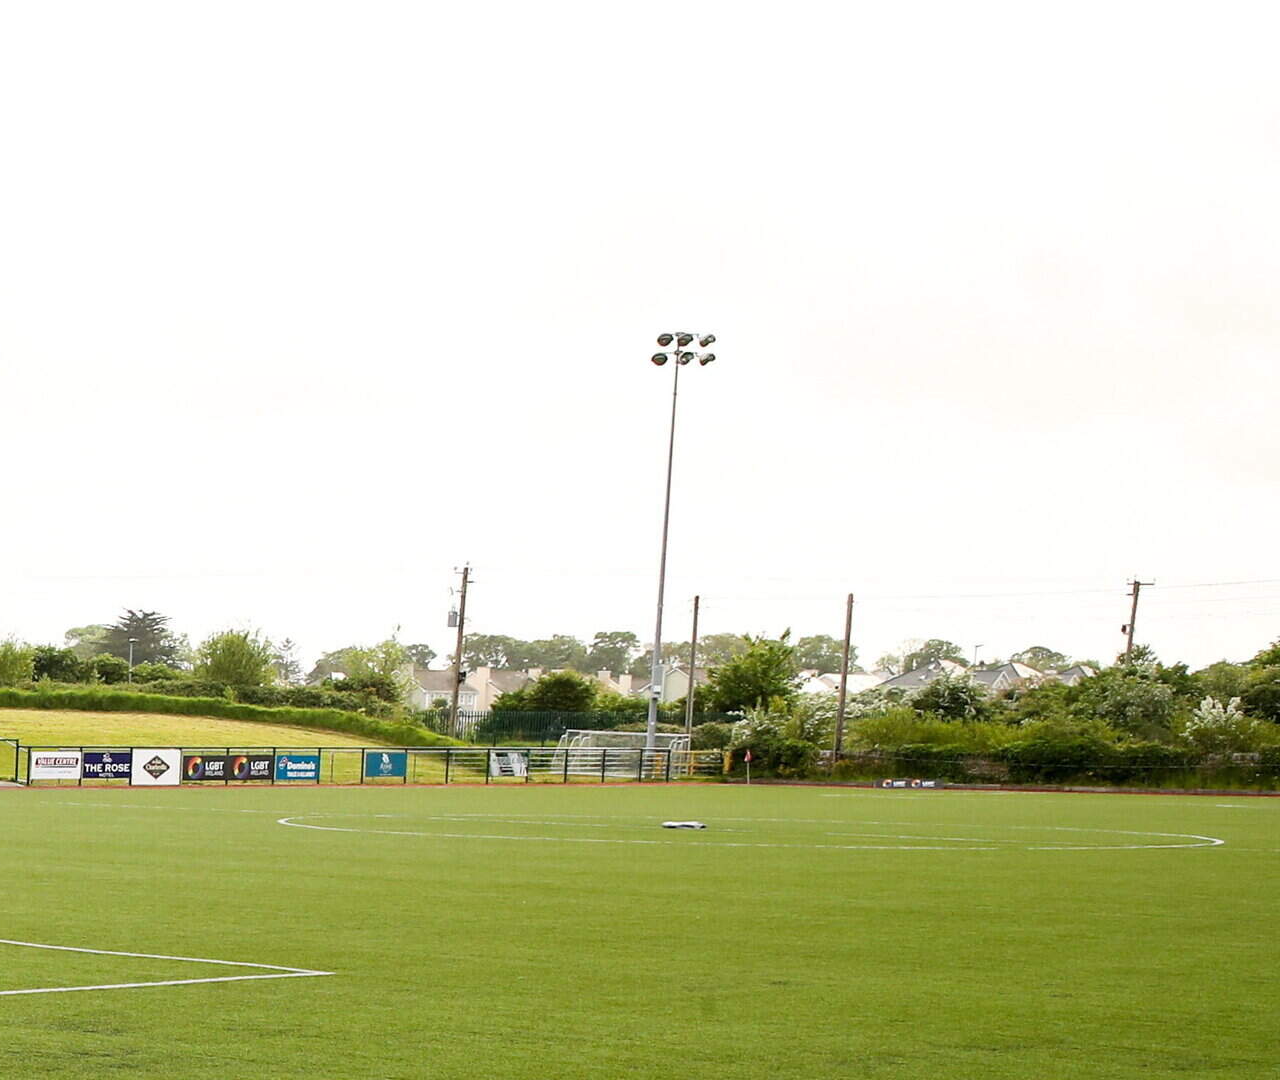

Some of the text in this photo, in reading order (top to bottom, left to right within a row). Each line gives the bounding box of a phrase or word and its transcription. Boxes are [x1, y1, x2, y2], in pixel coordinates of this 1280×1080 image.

[85, 763, 130, 772] THE ROSE
[205, 761, 224, 770] LGBT
[250, 761, 269, 770] LGBT
